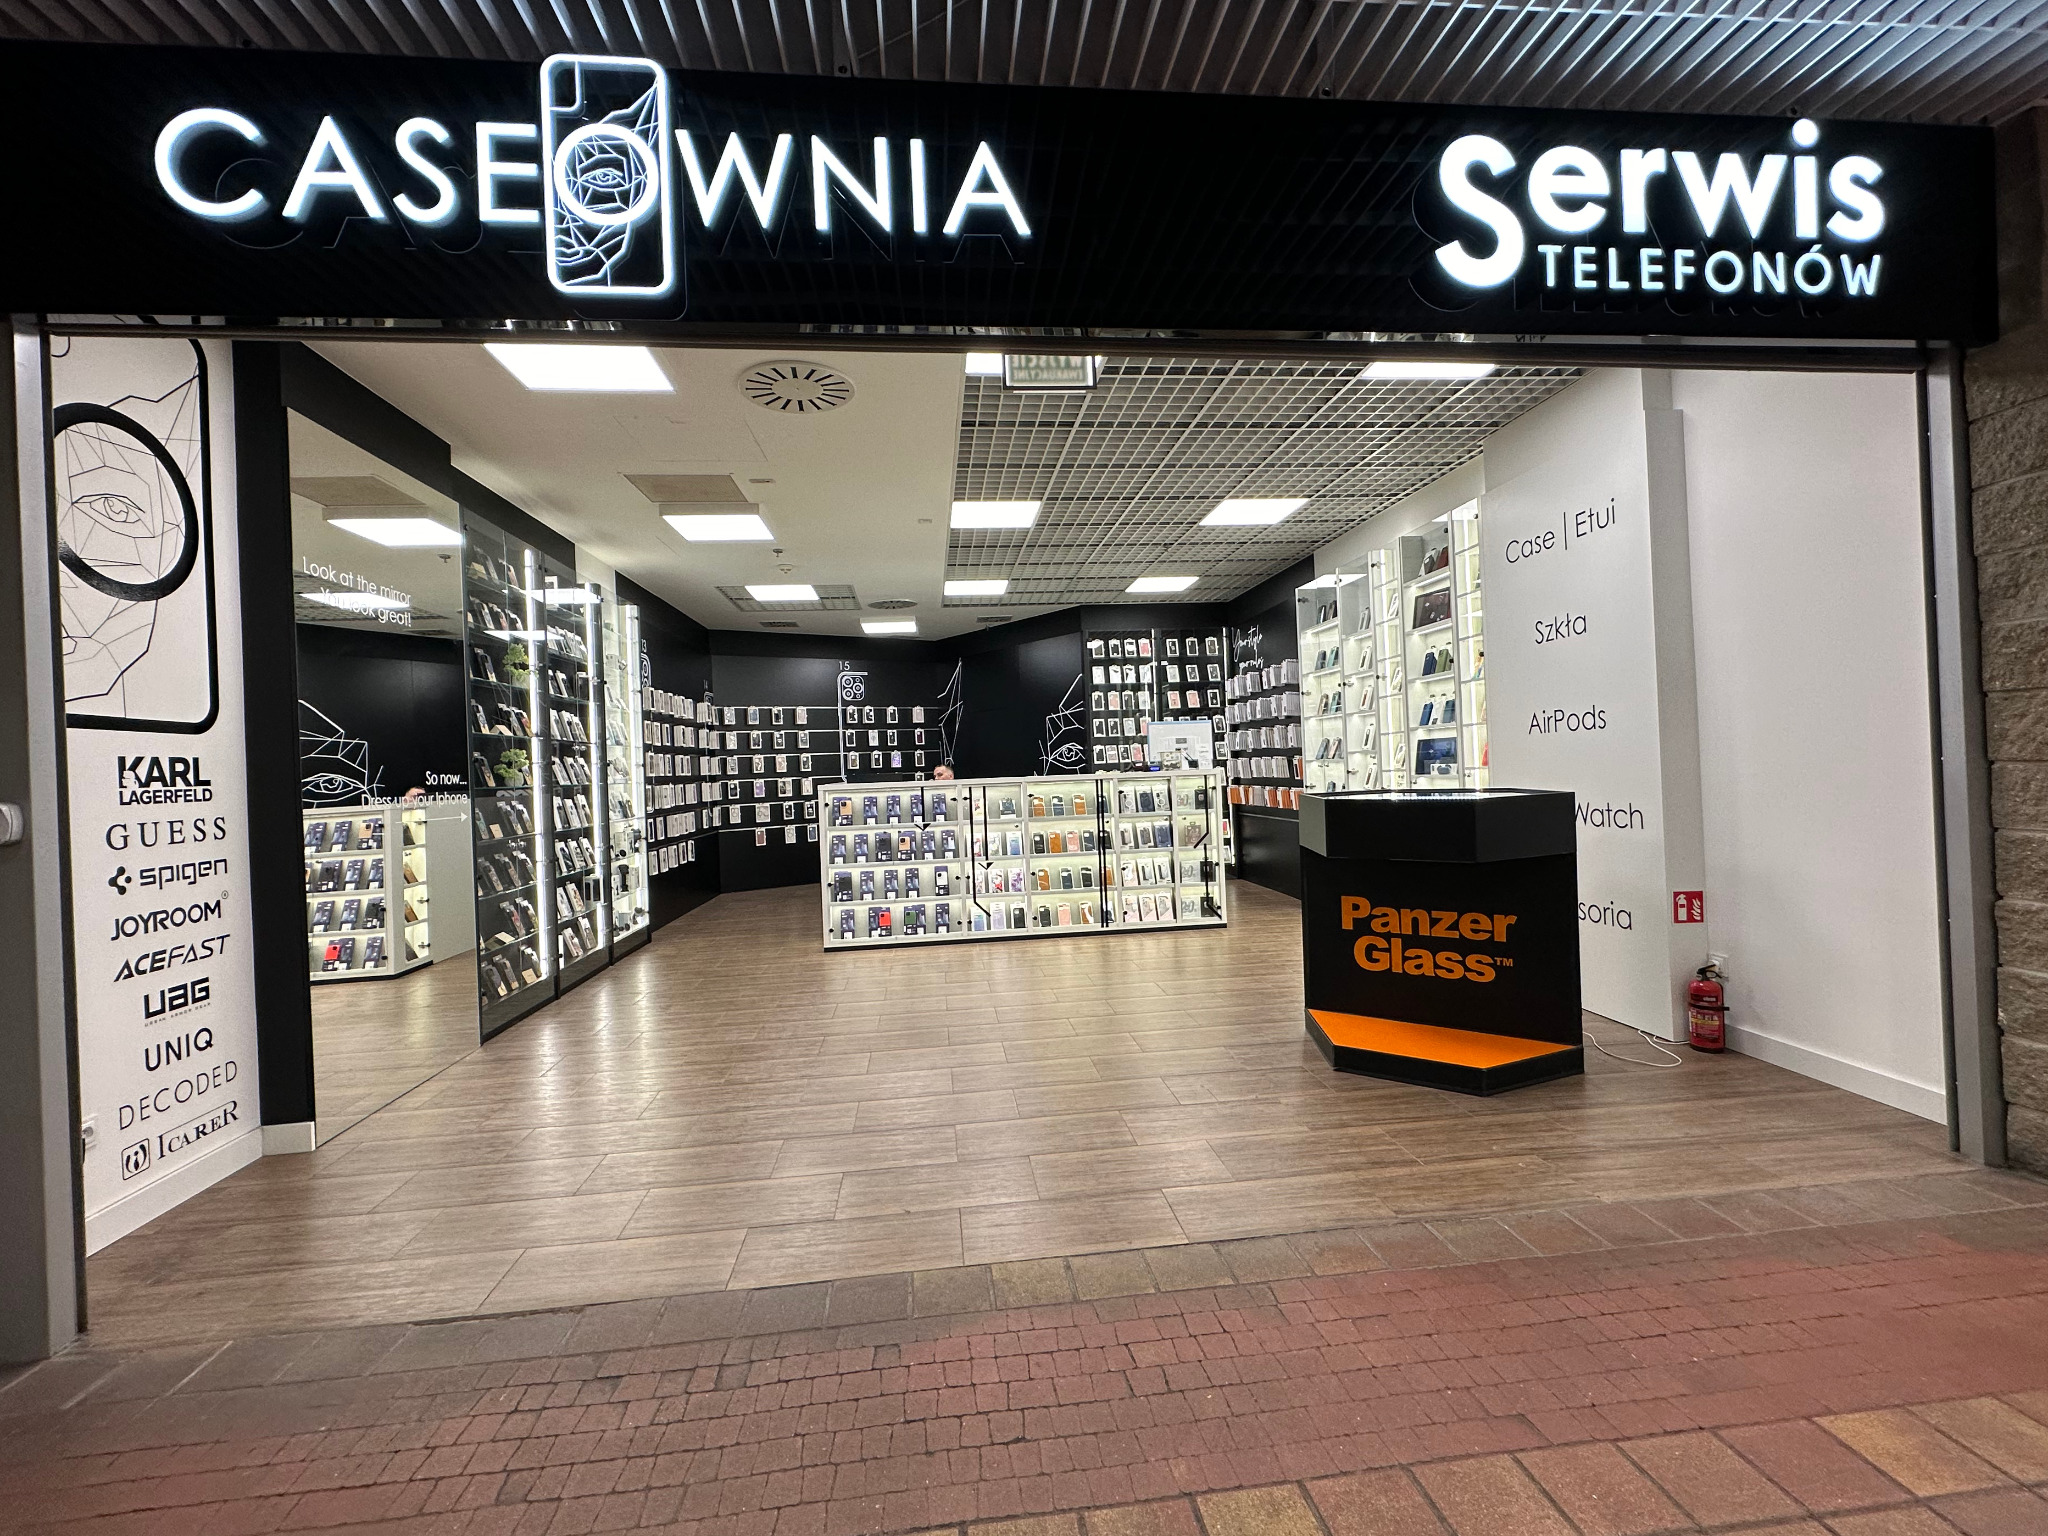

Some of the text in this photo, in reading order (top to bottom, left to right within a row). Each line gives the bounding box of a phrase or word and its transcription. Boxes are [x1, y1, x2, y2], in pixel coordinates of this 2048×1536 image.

[154, 107, 1032, 238] CASEOWNIA
[1435, 118, 1885, 288] Serwis
[1538, 244, 1882, 297] TELEFONÓW
[1505, 531, 1556, 564] Case
[1574, 497, 1616, 539] Etui
[302, 556, 411, 605] Look at the mirror
[377, 607, 412, 628] great!
[1534, 612, 1588, 645] Szkła
[839, 660, 851, 671] 15
[1528, 705, 1607, 735] AirPods
[117, 756, 212, 789] KARL
[425, 770, 438, 785] So
[119, 788, 213, 806] LAGERFELD
[361, 793, 392, 809] Dress
[394, 796, 409, 810] up
[411, 795, 434, 810] your
[1574, 802, 1645, 830] Watch
[105, 816, 227, 851] GUESS
[139, 858, 228, 890] spigen
[110, 899, 222, 942] JOYROOM
[1340, 895, 1518, 943] Panzer
[113, 933, 231, 983] ACEFAST
[1353, 935, 1496, 983] Glass
[143, 976, 210, 1020] UAG
[144, 1027, 214, 1072] UNIQ
[118, 1060, 238, 1131] DECODED
